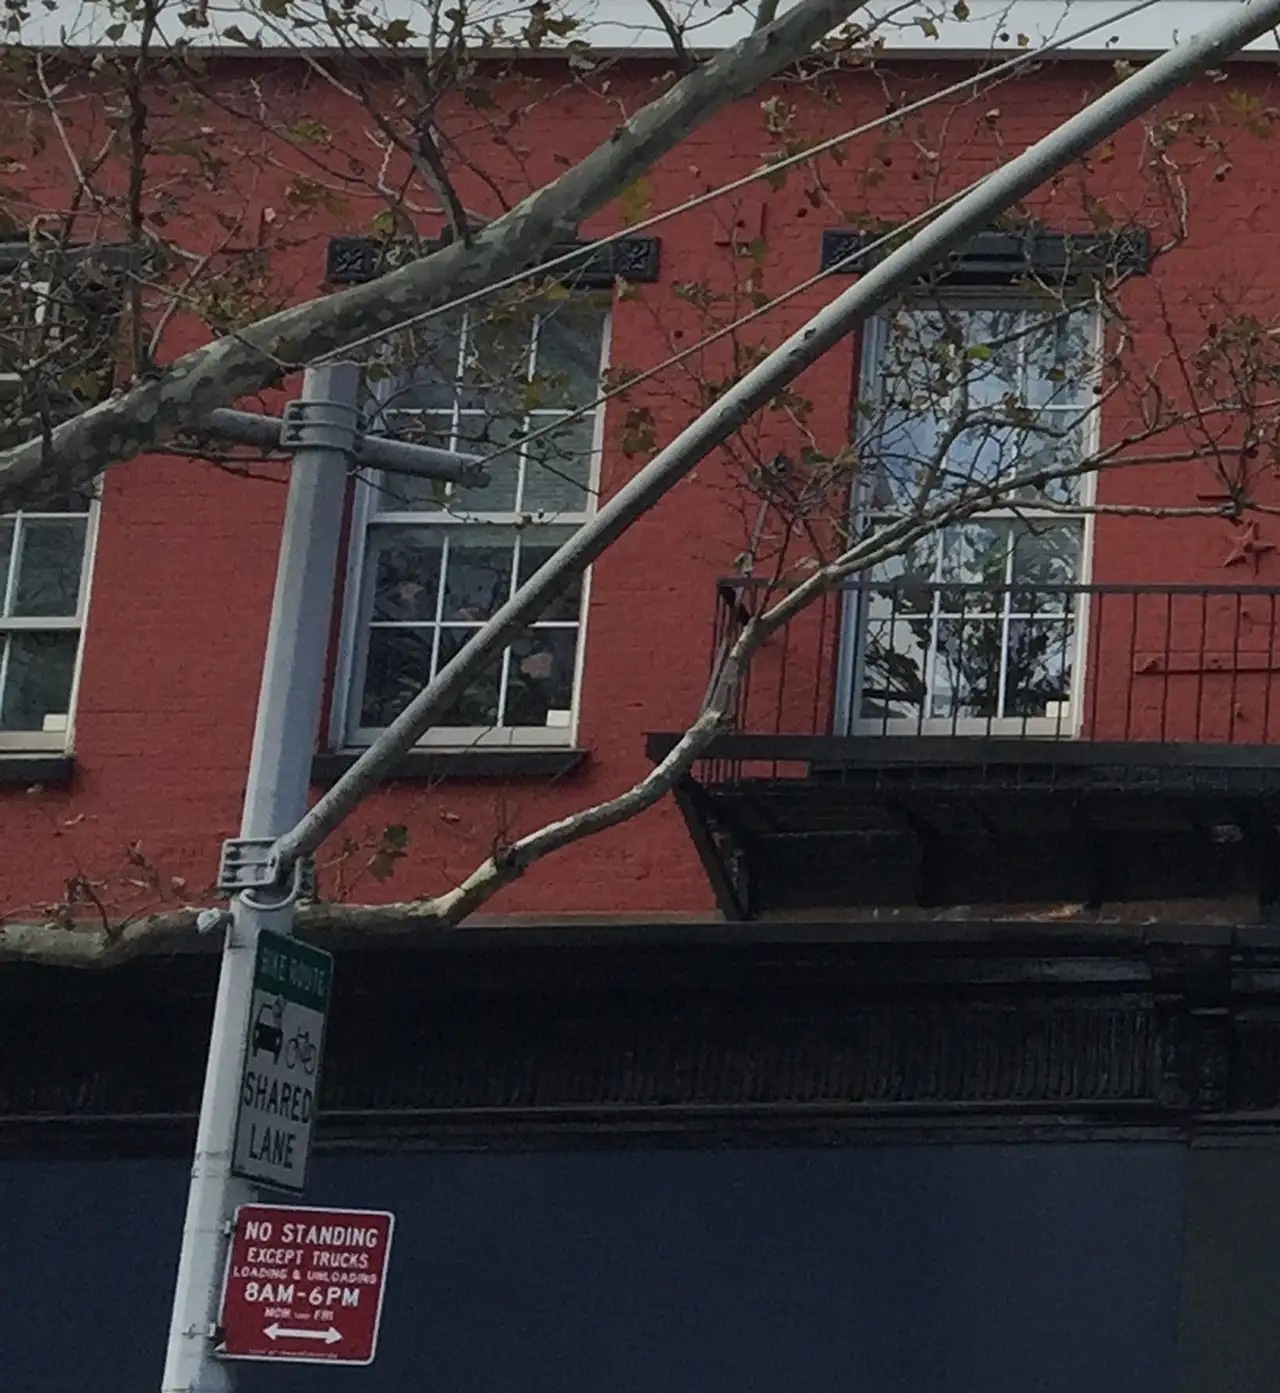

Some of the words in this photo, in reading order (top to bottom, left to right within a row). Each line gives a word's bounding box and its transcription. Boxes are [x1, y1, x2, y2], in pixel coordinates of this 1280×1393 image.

[244, 1070, 312, 1124] SHARED
[249, 1122, 297, 1170] LANE
[244, 1221, 273, 1242] NO
[281, 1223, 379, 1248] STANDING
[247, 1247, 304, 1266] EXCEPT
[312, 1251, 369, 1269] TRUCKS
[233, 1266, 288, 1281] LOADING
[307, 1270, 377, 1285] UNLOADING
